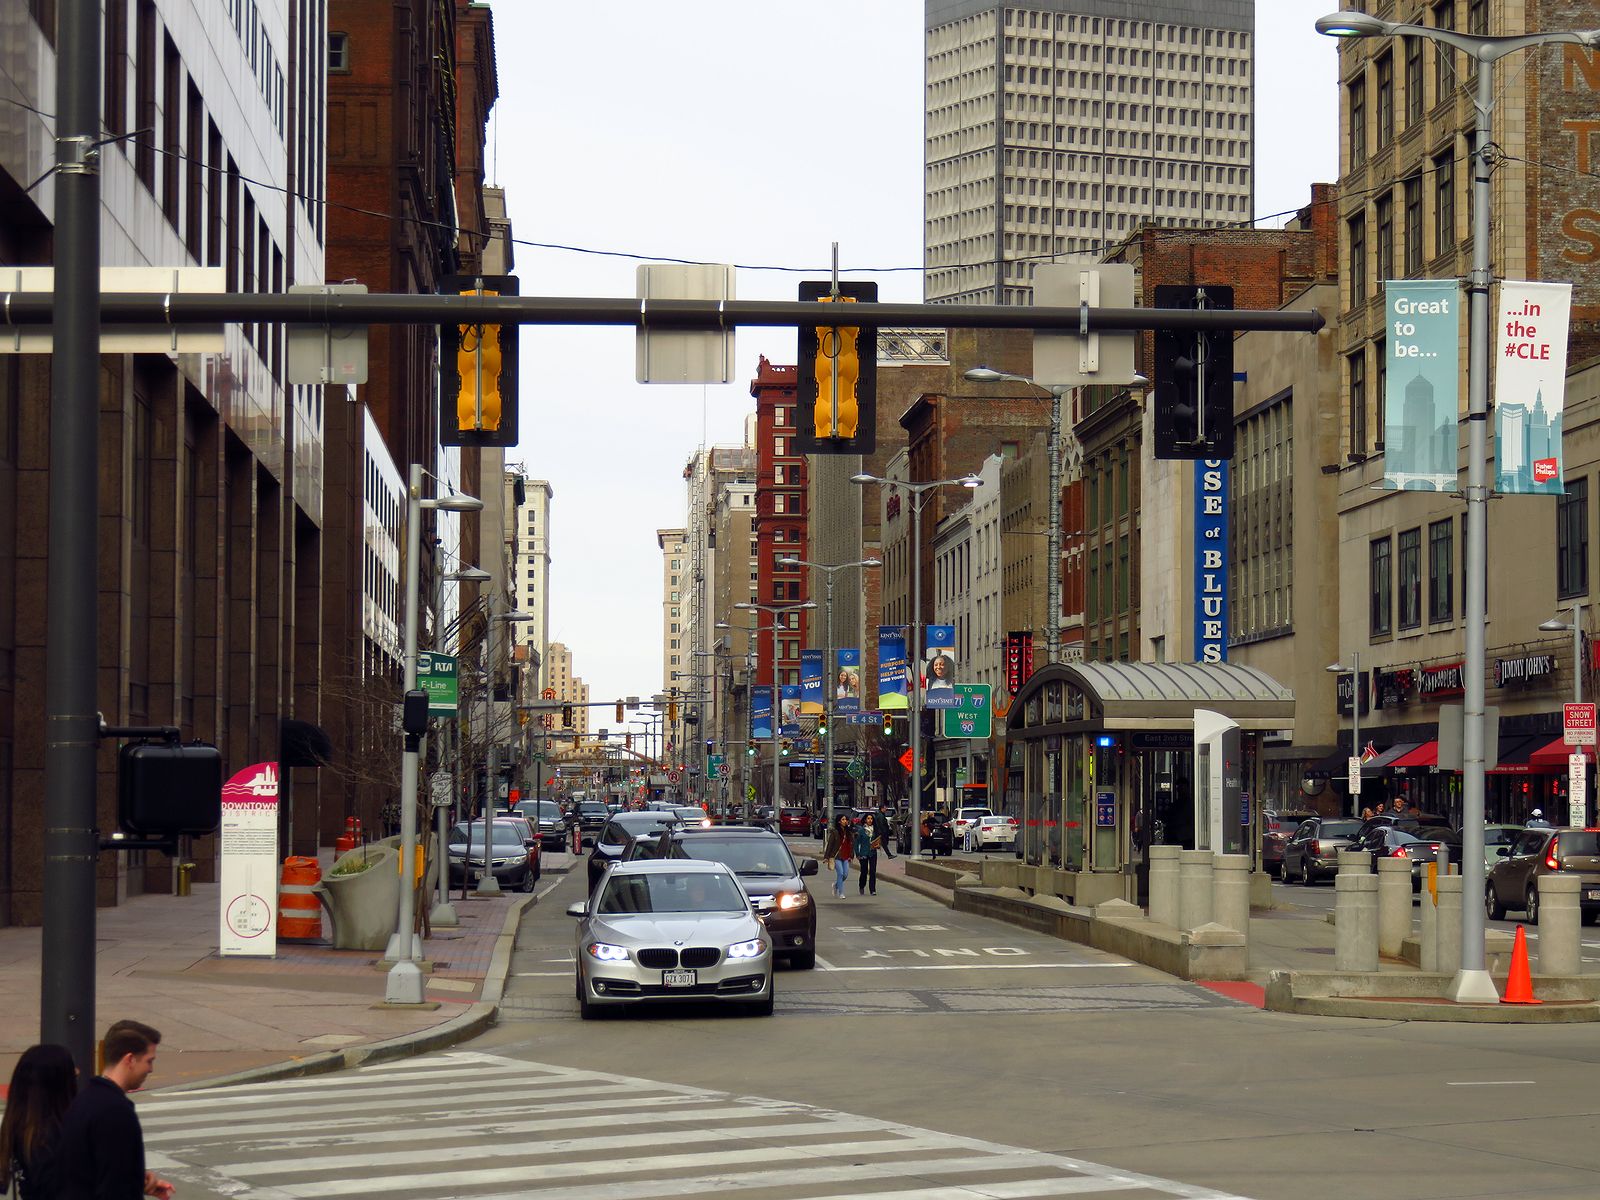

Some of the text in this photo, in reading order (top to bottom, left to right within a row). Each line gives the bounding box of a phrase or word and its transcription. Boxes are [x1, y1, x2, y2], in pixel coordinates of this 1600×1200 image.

[1394, 298, 1448, 315] Great
[1506, 300, 1540, 316] ...in
[1394, 320, 1415, 336] to
[1506, 321, 1536, 338] the
[1394, 341, 1437, 358] be...
[1505, 342, 1550, 360] #CLE
[1535, 462, 1553, 471] Fisher
[1205, 528, 1220, 538] of
[1202, 550, 1223, 664] BLUES
[435, 662, 452, 672] RTA
[1502, 656, 1550, 684] JIMMY JOHN'S
[421, 680, 447, 689] E-Line
[804, 682, 821, 690] YOU
[954, 698, 983, 706] 71 77
[860, 947, 1032, 958] ONLY
